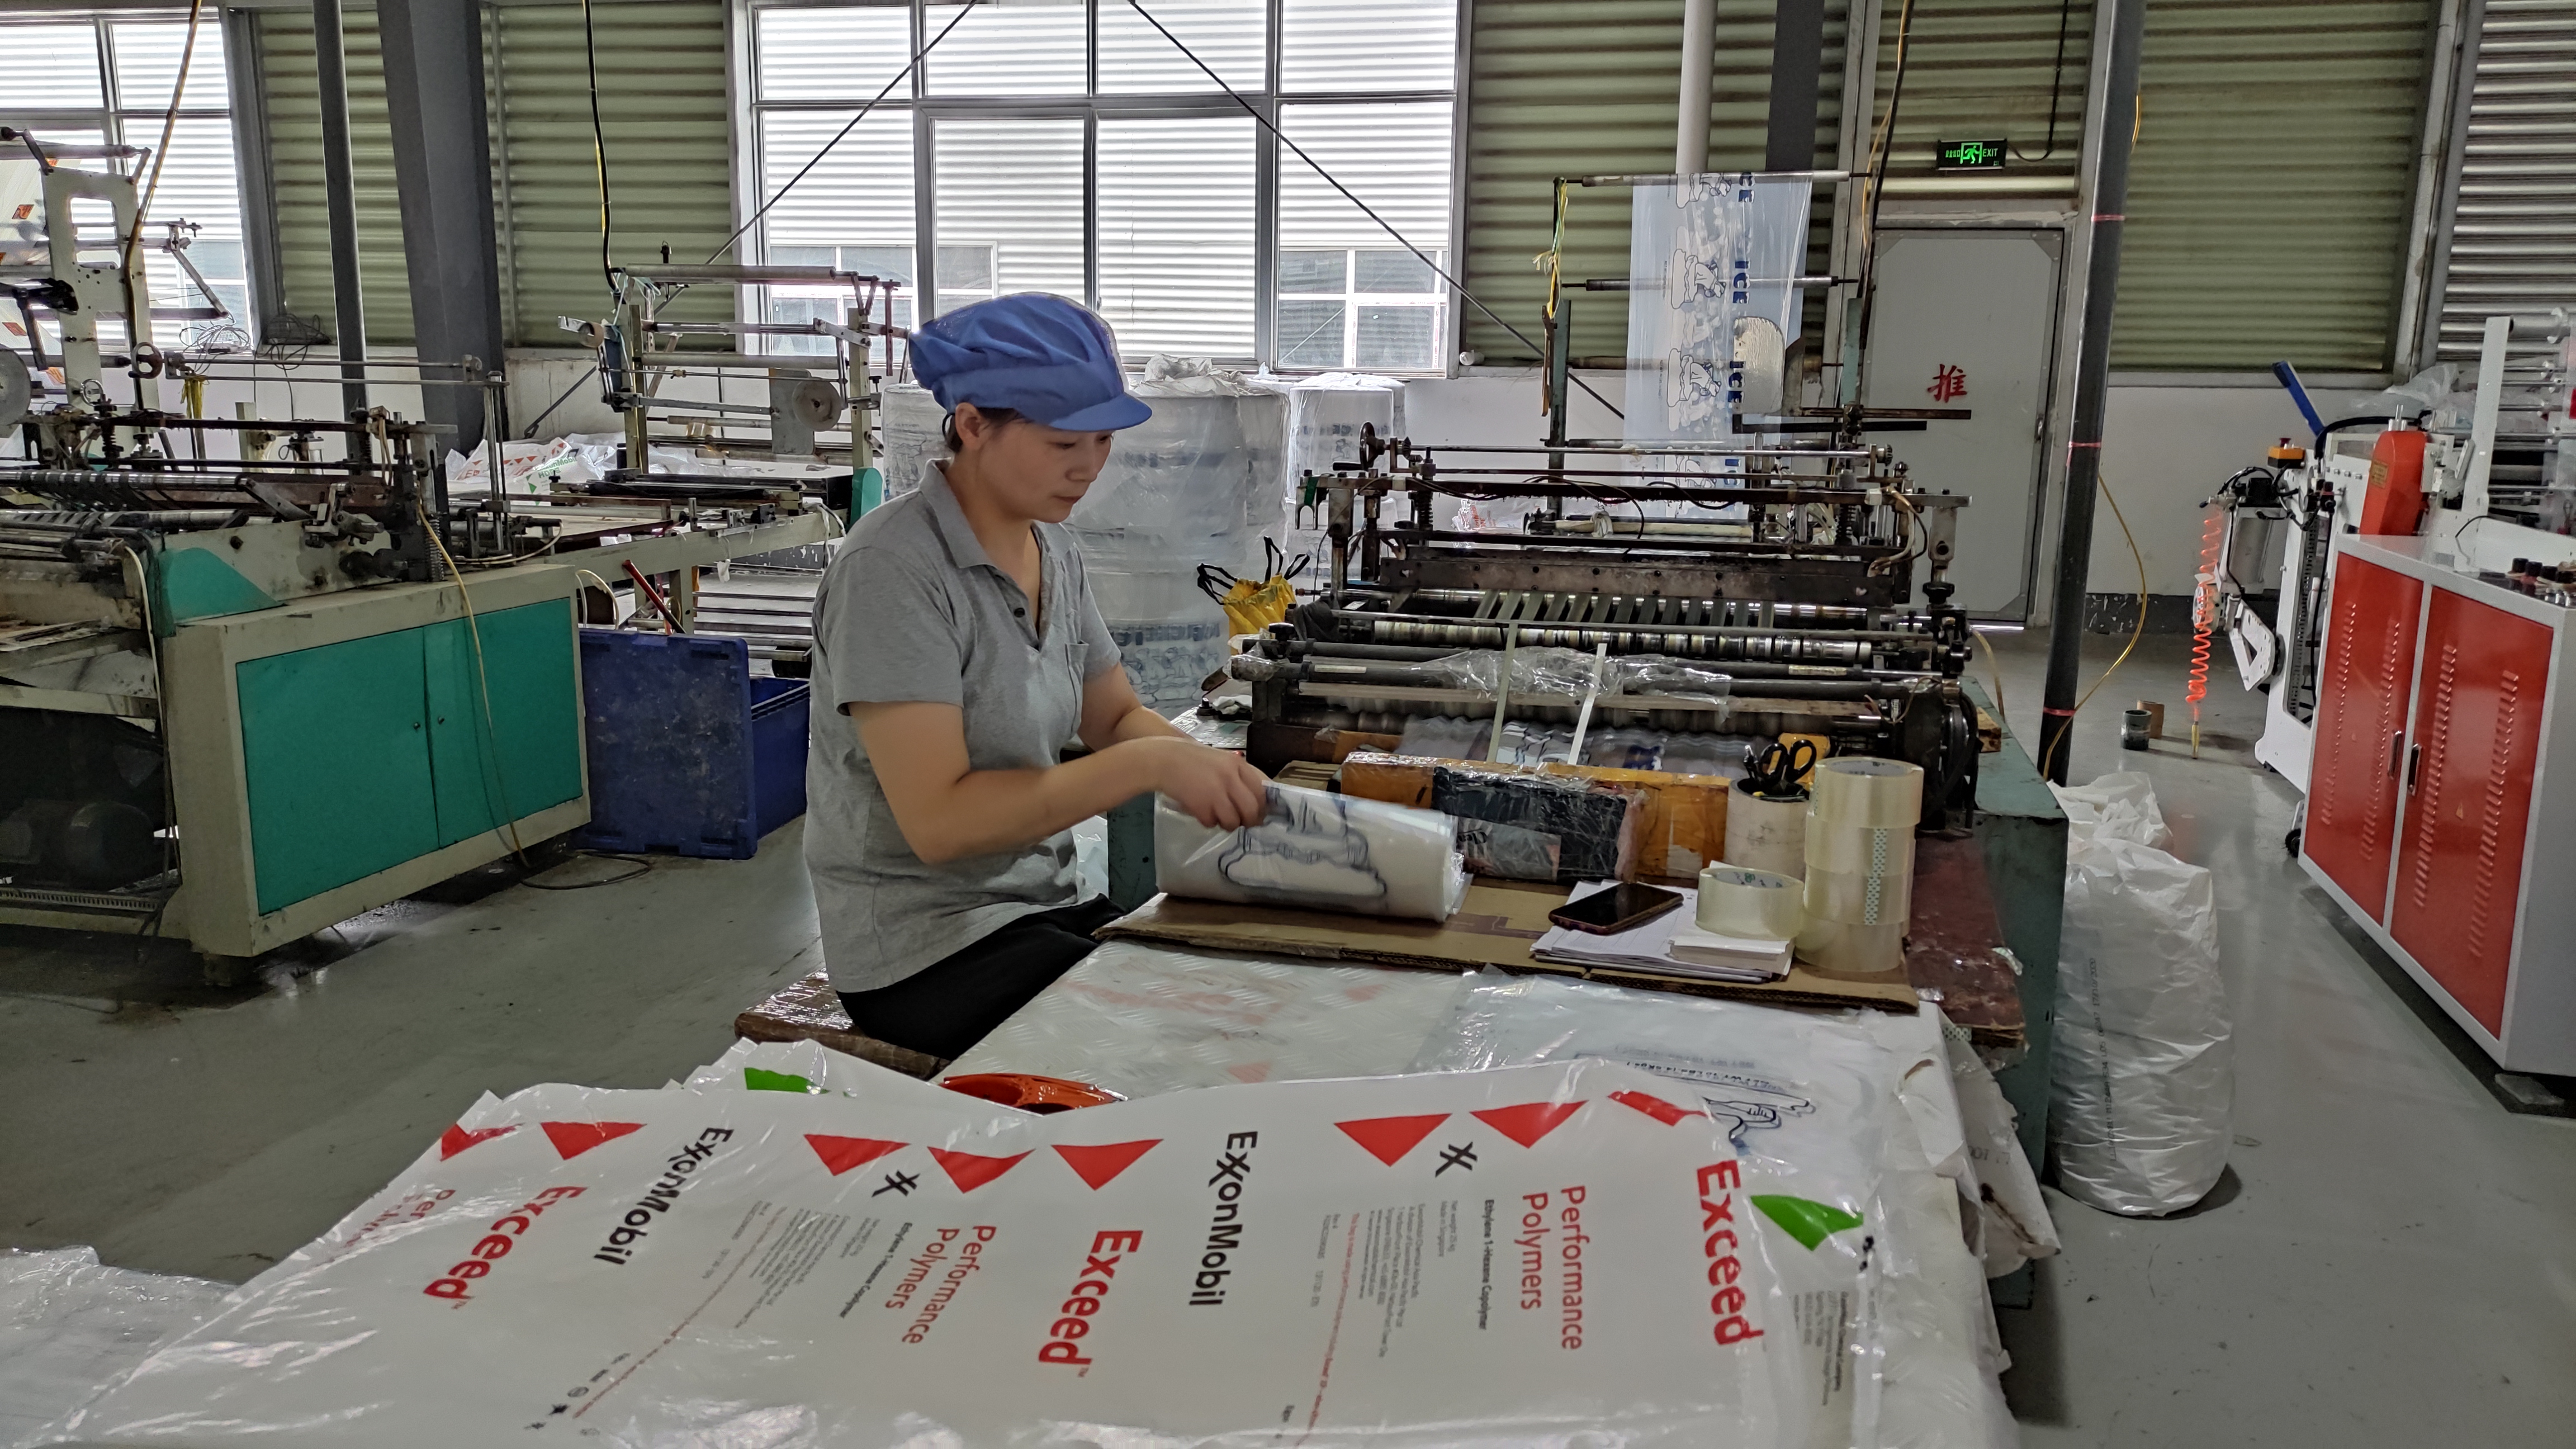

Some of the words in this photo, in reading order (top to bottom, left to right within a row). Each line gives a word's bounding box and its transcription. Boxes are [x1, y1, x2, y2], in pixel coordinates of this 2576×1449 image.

[1982, 148, 1999, 157] EXIT
[1732, 261, 1751, 304] ICE
[1727, 361, 1745, 402] ICE
[1927, 364, 1967, 403] 推
[593, 1127, 734, 1265] ExxonMobil
[1188, 1131, 1258, 1306] ExxonMobil
[1514, 1192, 1550, 1310] Polymers
[1696, 1160, 1764, 1346] Exceed
[886, 1228, 960, 1309] Polymers
[902, 1225, 997, 1344] Performance
[1561, 1185, 1591, 1350] Performance
